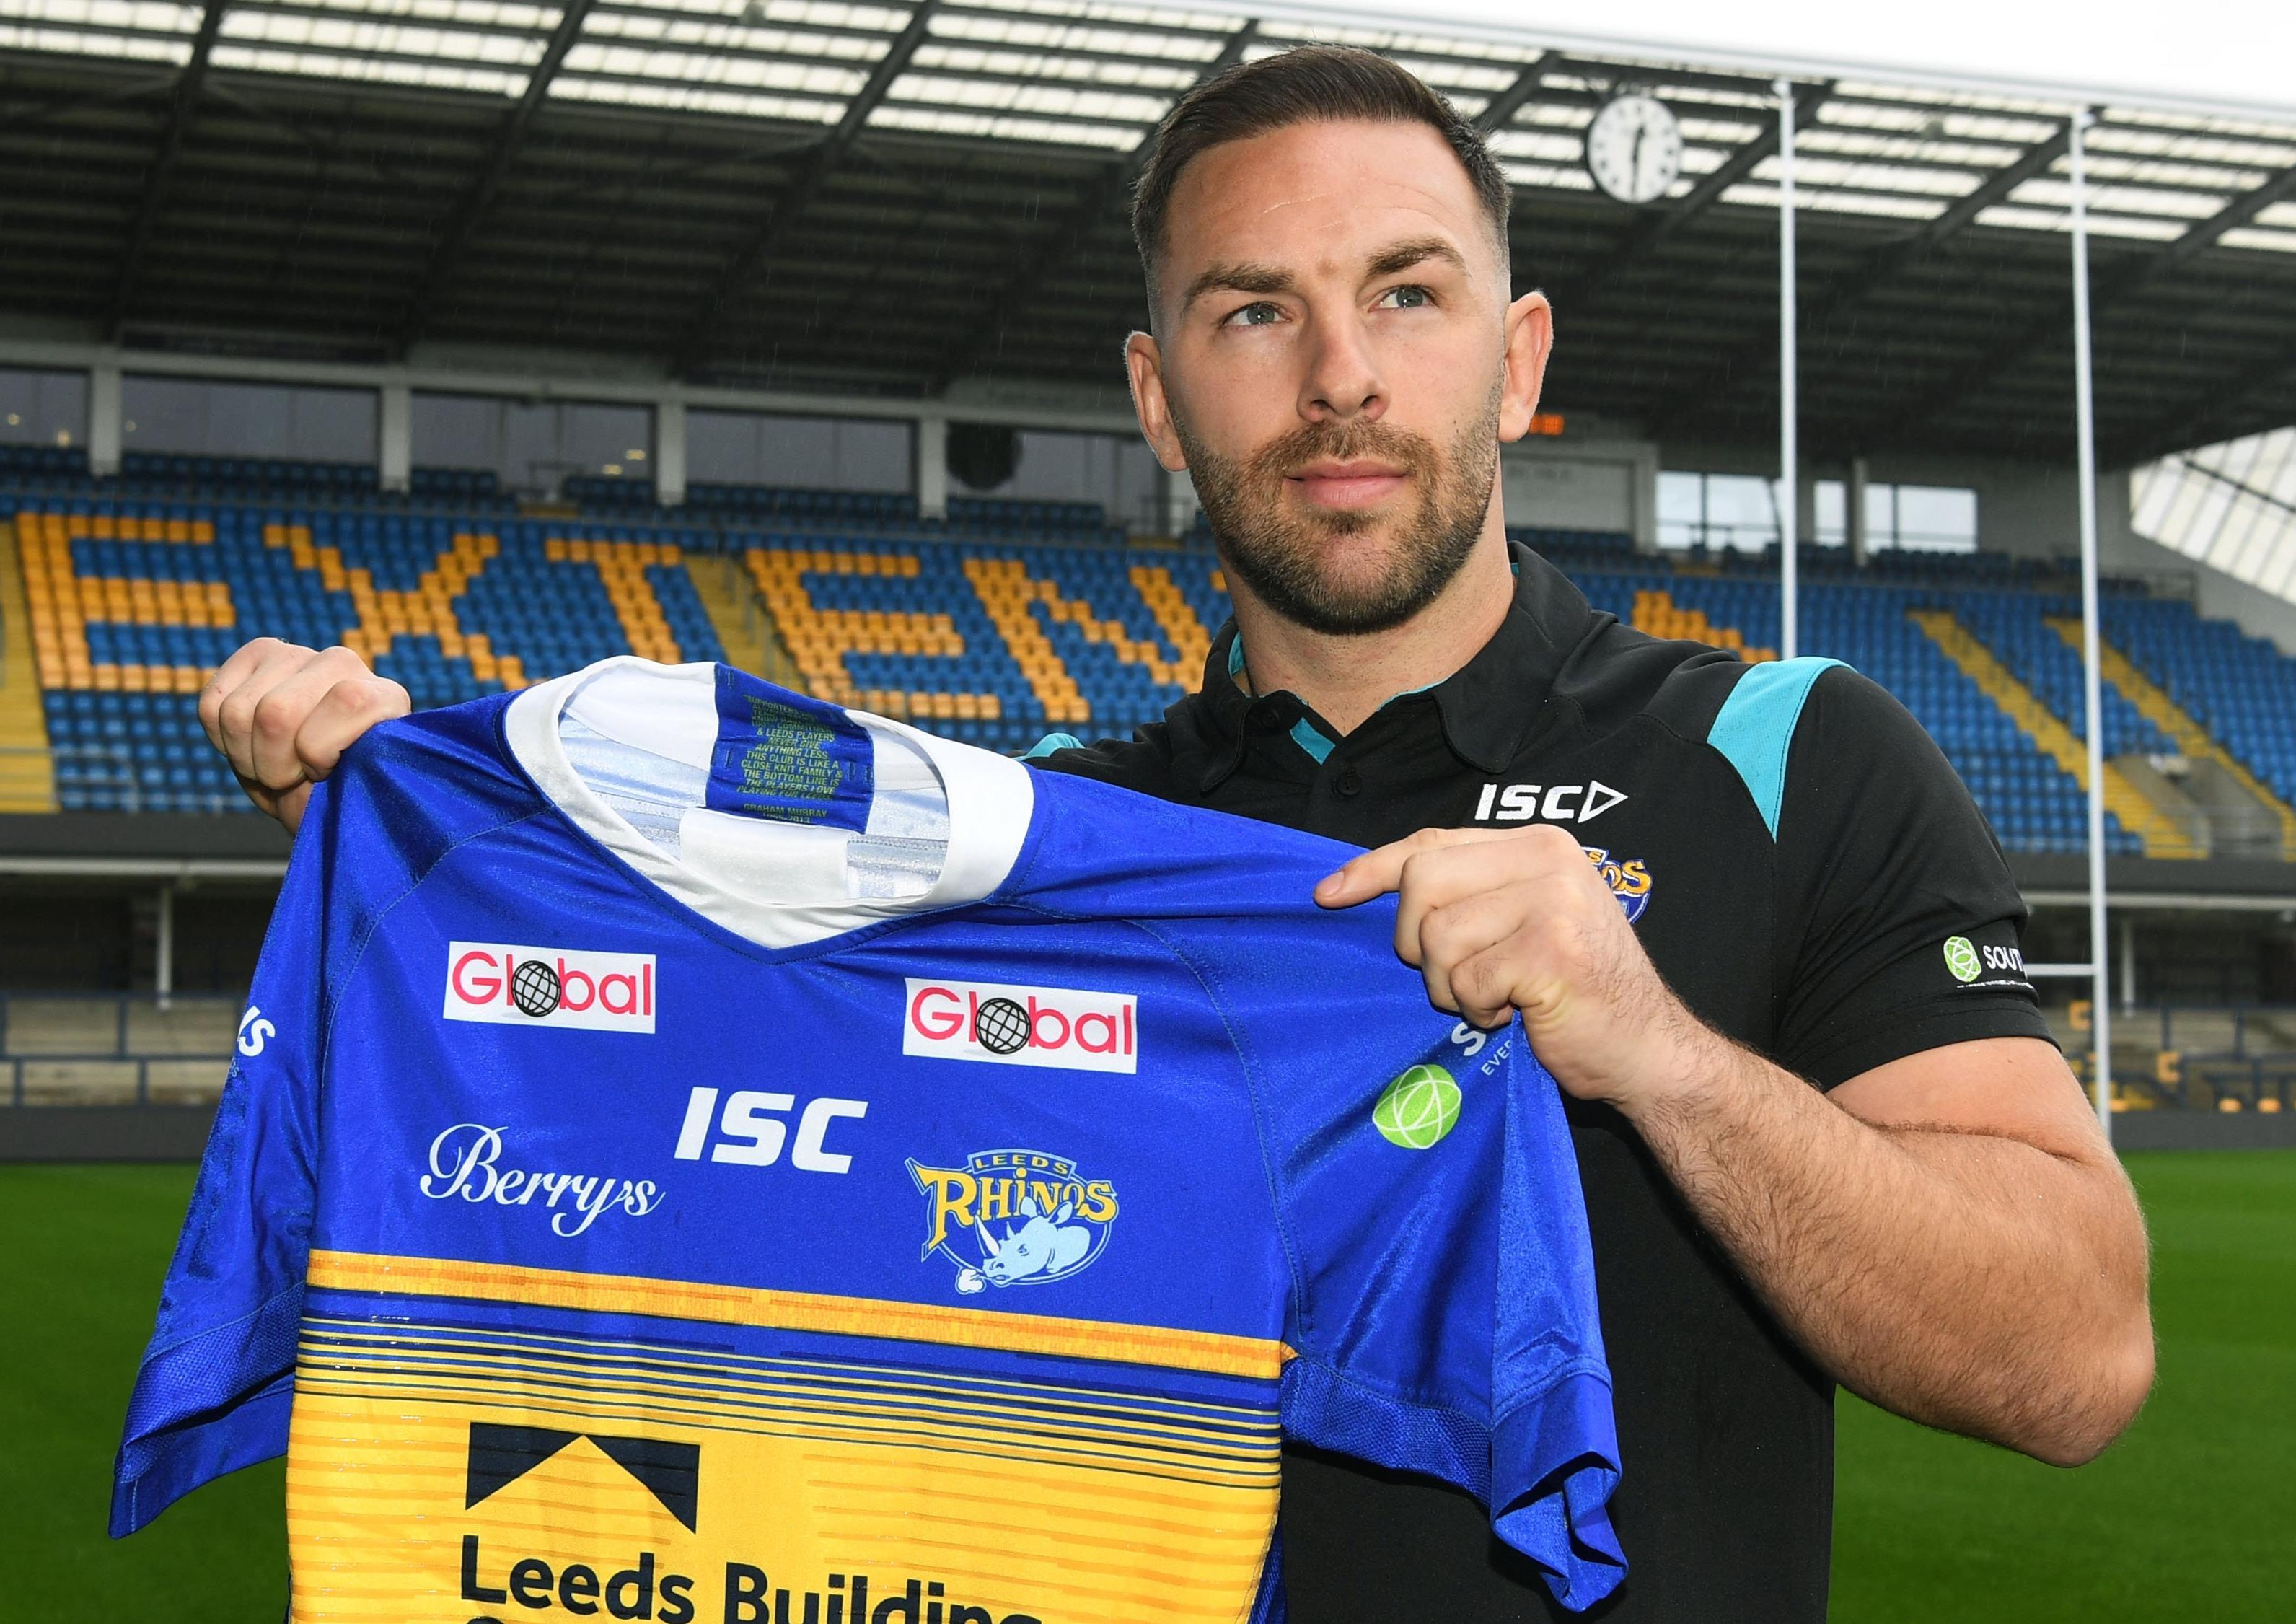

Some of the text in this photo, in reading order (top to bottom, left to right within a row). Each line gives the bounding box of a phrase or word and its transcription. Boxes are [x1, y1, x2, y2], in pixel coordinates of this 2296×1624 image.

[766, 729, 794, 738] LEEDS
[796, 731, 835, 742] PLAYERS
[767, 737, 821, 750] NEVER GIVE
[747, 750, 766, 760] THIS
[769, 754, 793, 765] CLUB
[809, 759, 830, 768] LIKE
[755, 743, 828, 760] ANYTHING LESS
[741, 759, 771, 771] CLOSE
[773, 764, 796, 773] KNIT
[798, 766, 834, 778] FAMILY
[744, 768, 840, 787] THE BOTTOM LINE IS
[736, 785, 776, 796] PLAYING
[746, 778, 762, 787] THE
[765, 781, 809, 791] PLAYERS
[744, 804, 827, 817] GRAHAM MURRAY
[1475, 784, 1583, 820] ISC
[1983, 945, 2027, 979] SOUT
[674, 1086, 869, 1174] ISC
[975, 1154, 1070, 1176] LEEDS
[460, 1535, 1044, 1624] Leeds Buildi
